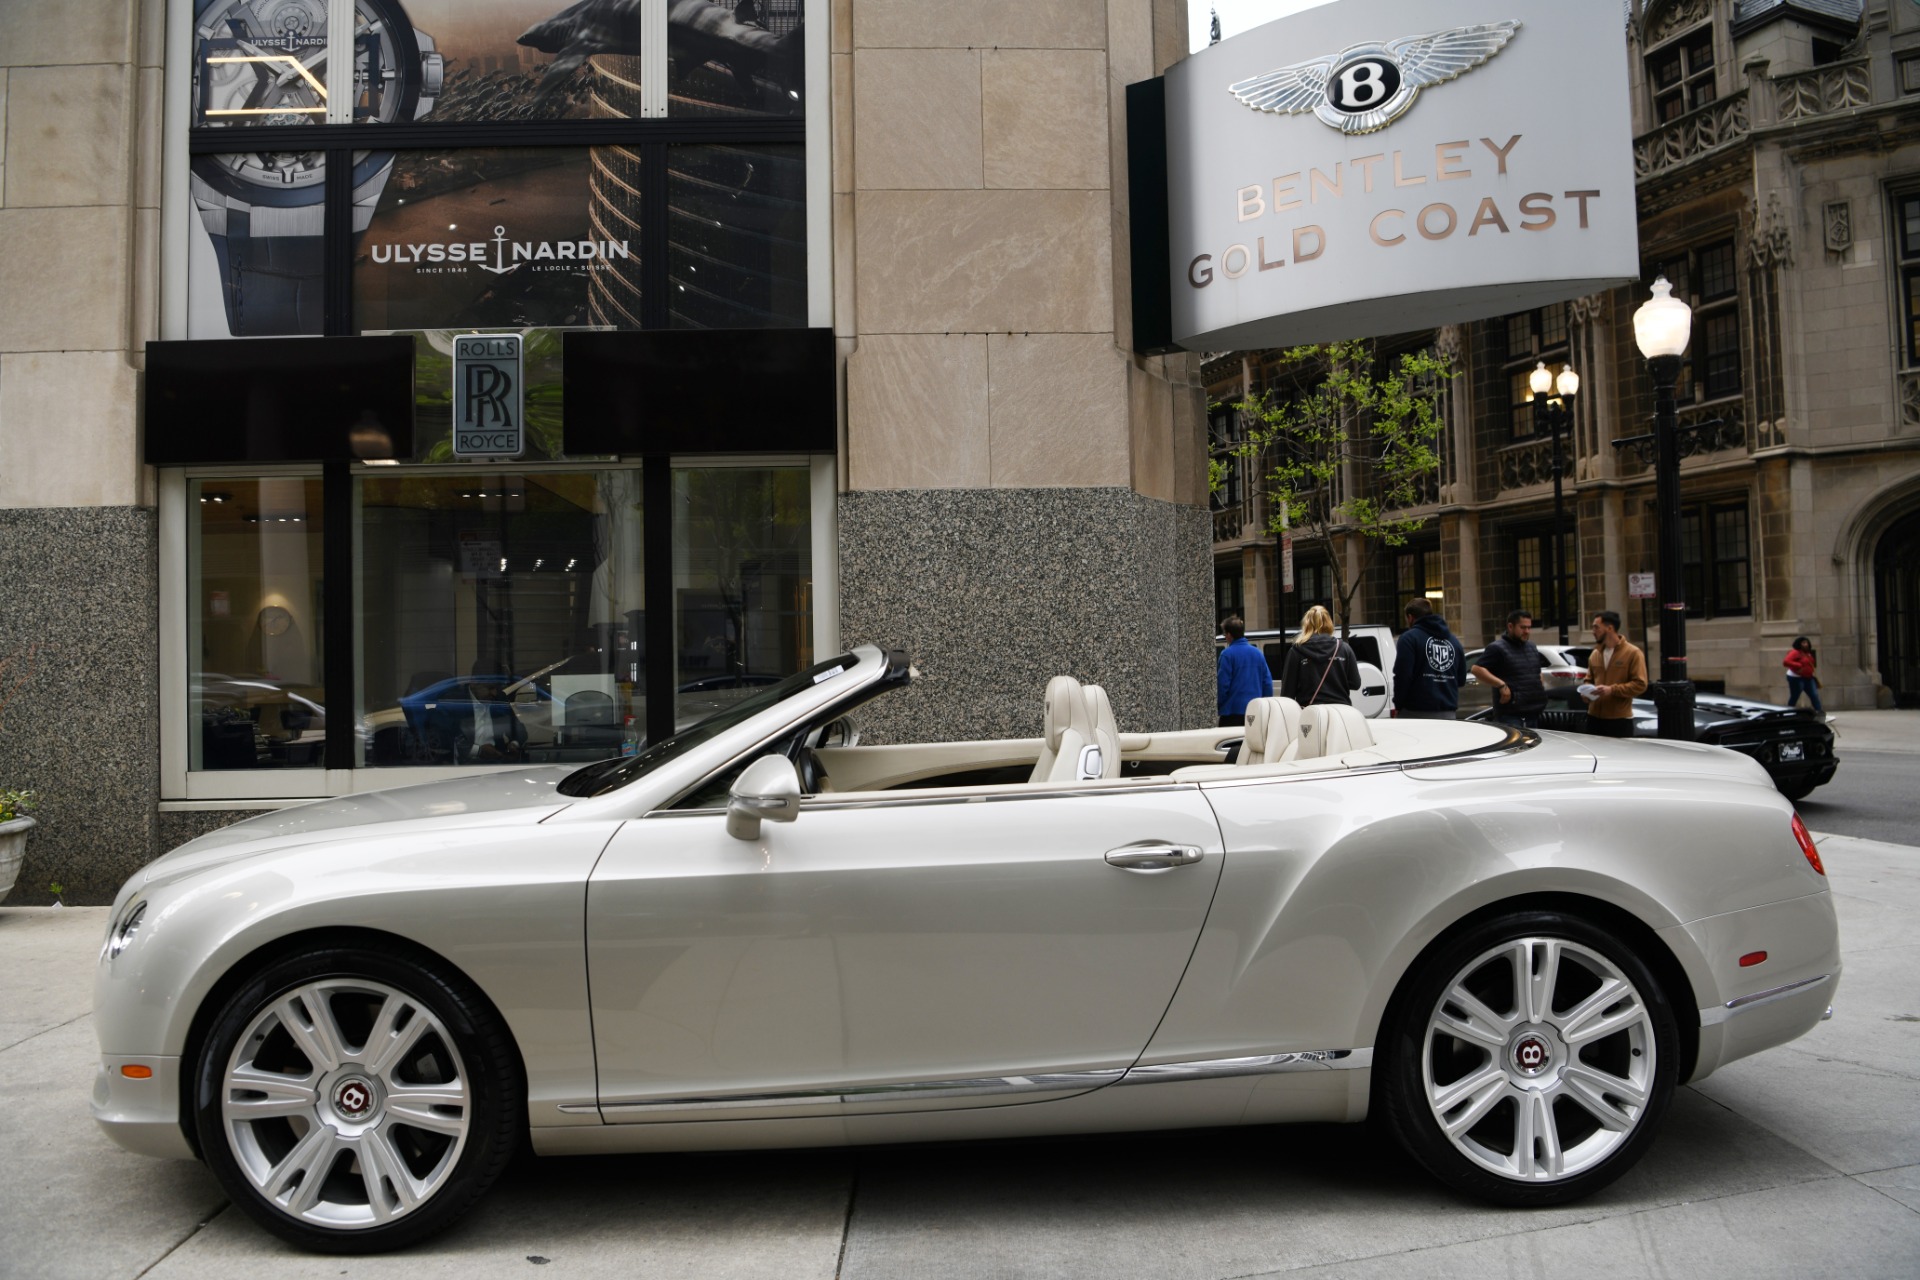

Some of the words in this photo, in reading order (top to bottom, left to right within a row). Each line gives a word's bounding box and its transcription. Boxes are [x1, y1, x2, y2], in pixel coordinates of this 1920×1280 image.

[251, 39, 287, 47] ULYSSE
[295, 38, 327, 46] NARDI
[1339, 60, 1387, 107] B
[1237, 134, 1523, 224] BENTLEY
[1188, 225, 1326, 289] GOLD
[1369, 189, 1601, 248] COAST
[371, 242, 488, 264] ULYSSE
[511, 240, 629, 261] NARDIN
[460, 341, 515, 356] ROLLS
[460, 434, 515, 449] ROYCE
[1433, 645, 1448, 663] HC
[1522, 1045, 1541, 1064] B
[342, 1087, 365, 1109] B
